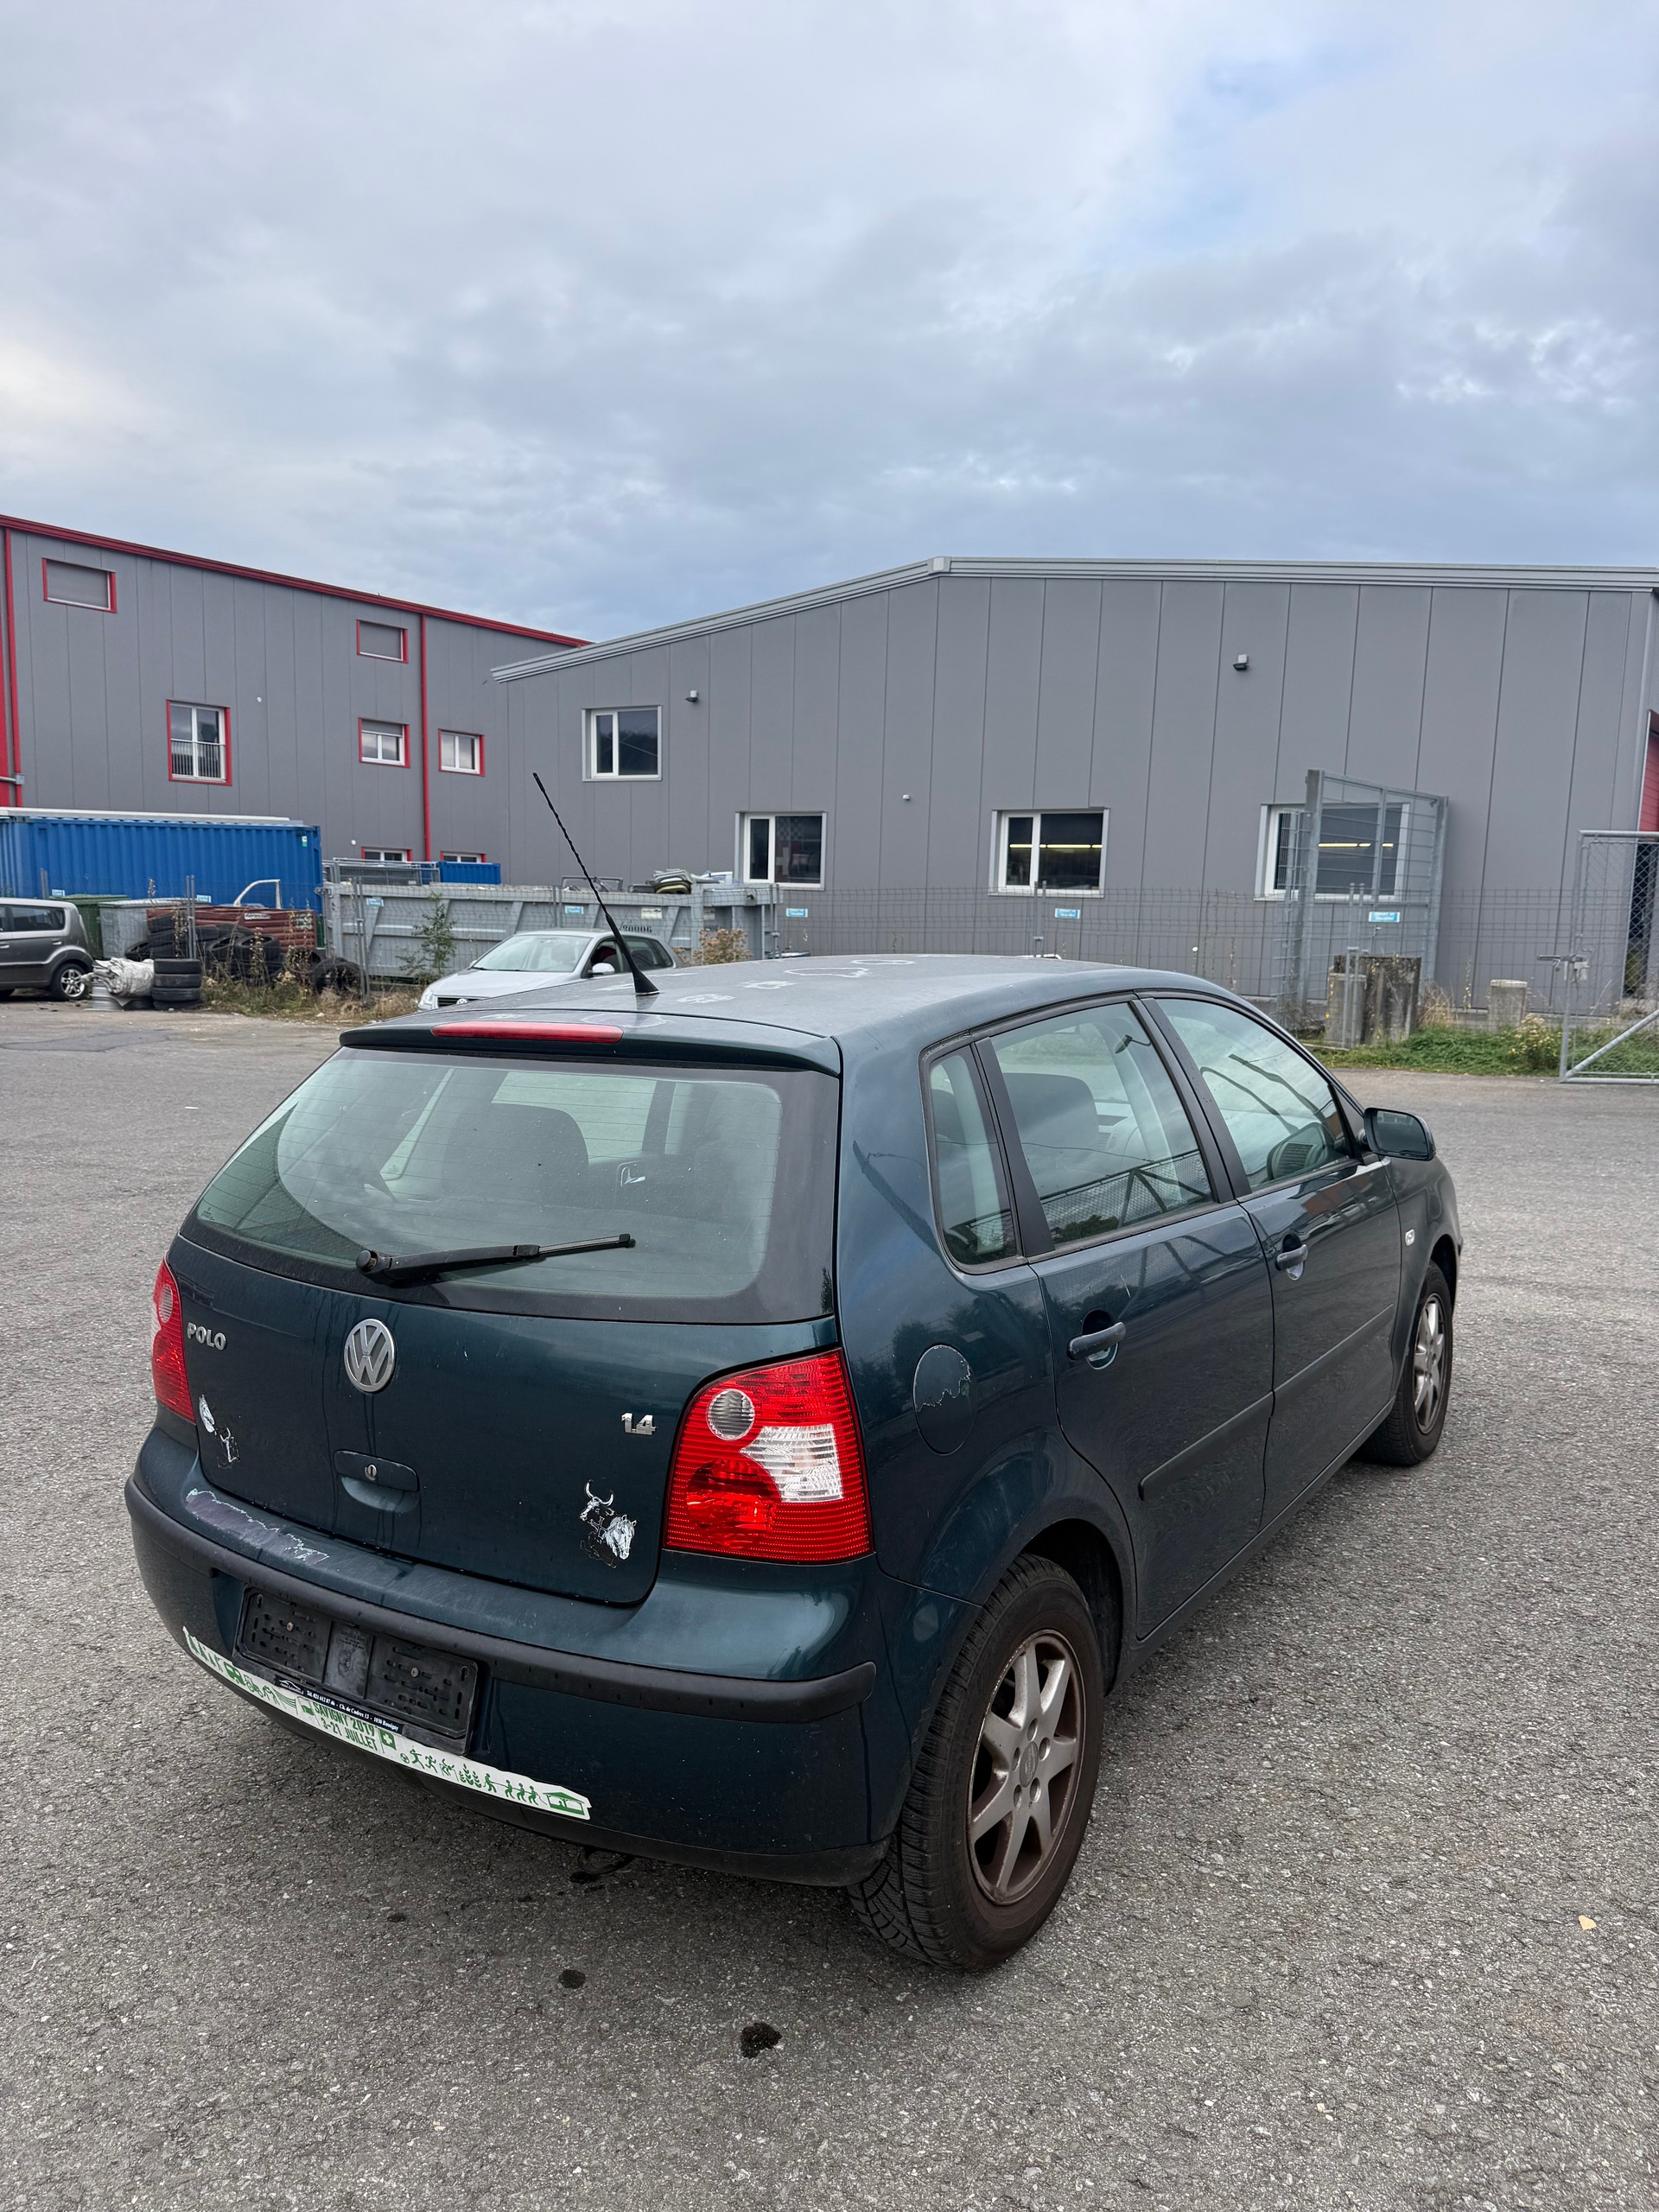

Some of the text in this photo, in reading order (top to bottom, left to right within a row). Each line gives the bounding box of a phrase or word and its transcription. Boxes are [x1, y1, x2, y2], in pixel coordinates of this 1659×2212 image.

[187, 1322, 226, 1351] POLO
[620, 1413, 657, 1436] 1.4
[313, 1701, 375, 1736] SAVIGNY 2019
[321, 1717, 378, 1751] 3-21 JUILLET
